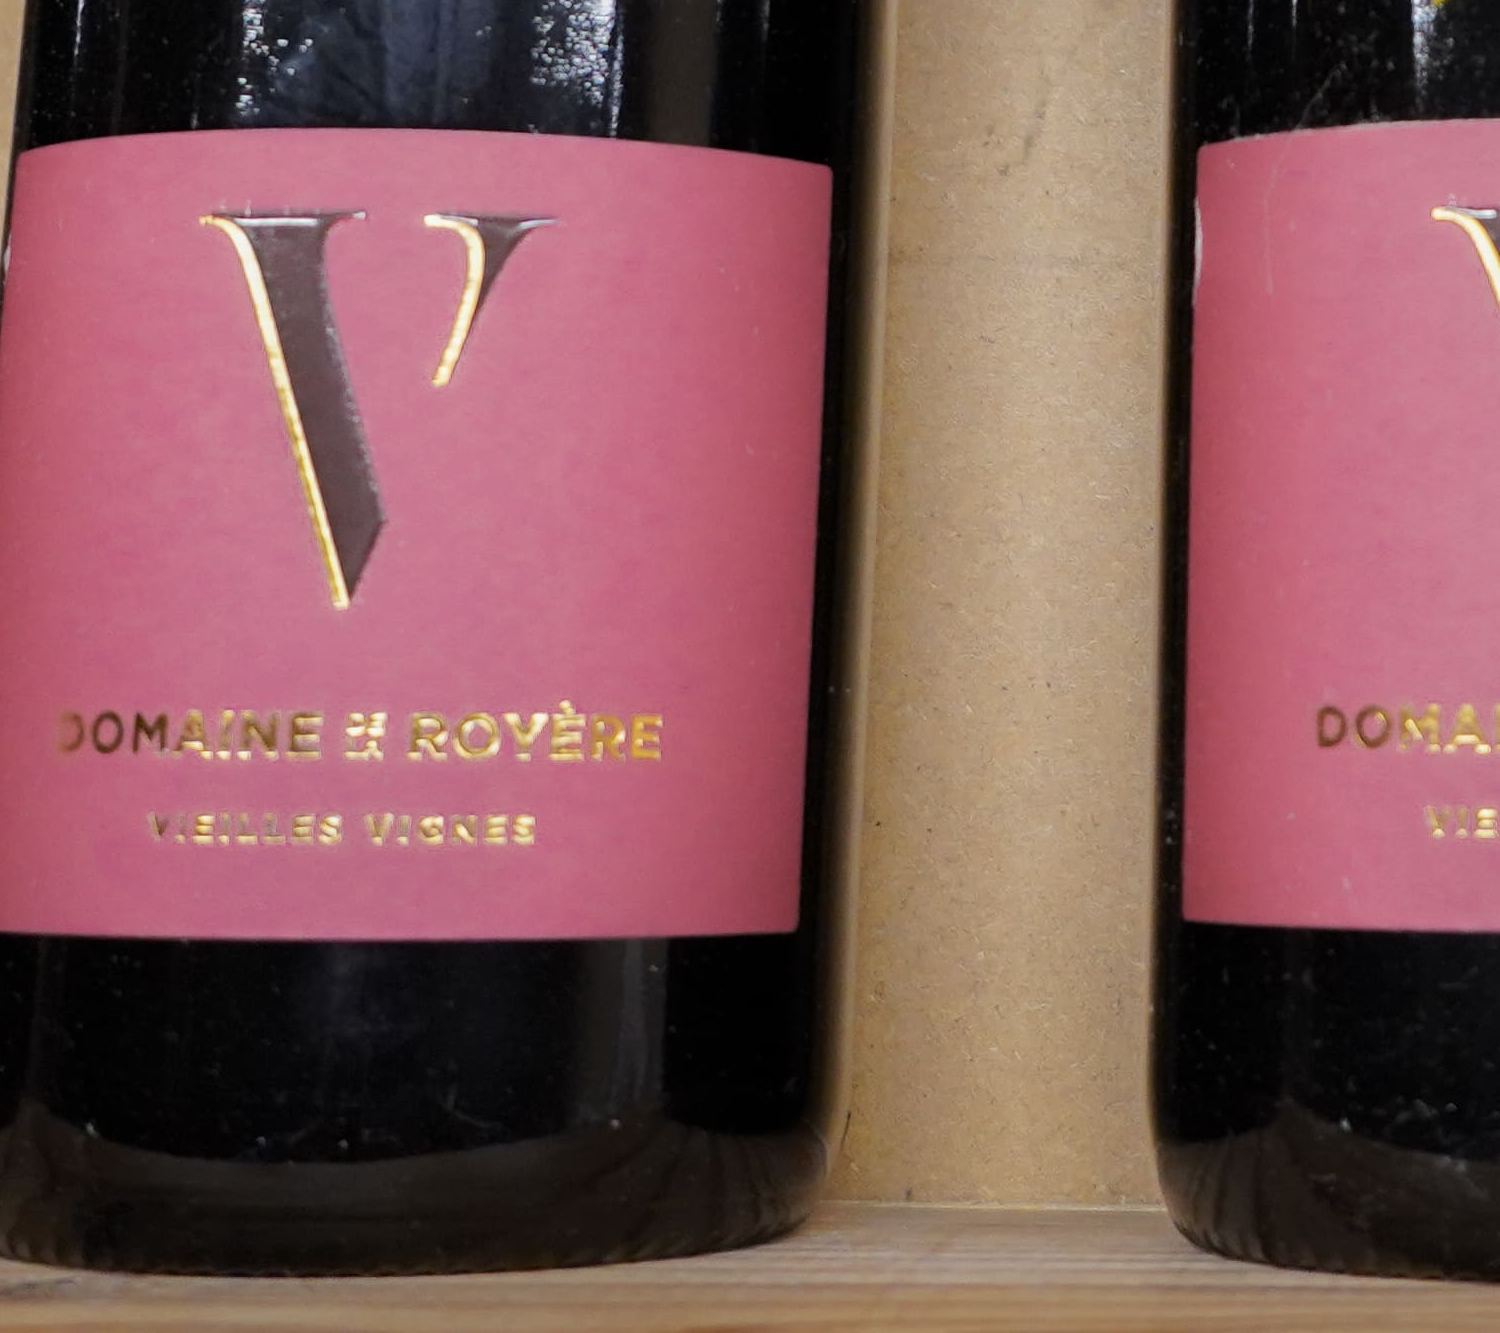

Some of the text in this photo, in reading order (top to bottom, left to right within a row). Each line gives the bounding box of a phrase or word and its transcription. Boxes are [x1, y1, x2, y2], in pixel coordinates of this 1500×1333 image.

[198, 205, 553, 609] V
[60, 709, 324, 761] DOMAINE
[406, 699, 663, 761] ROYÈRE
[148, 811, 536, 846] VIEILLES VIGNES
